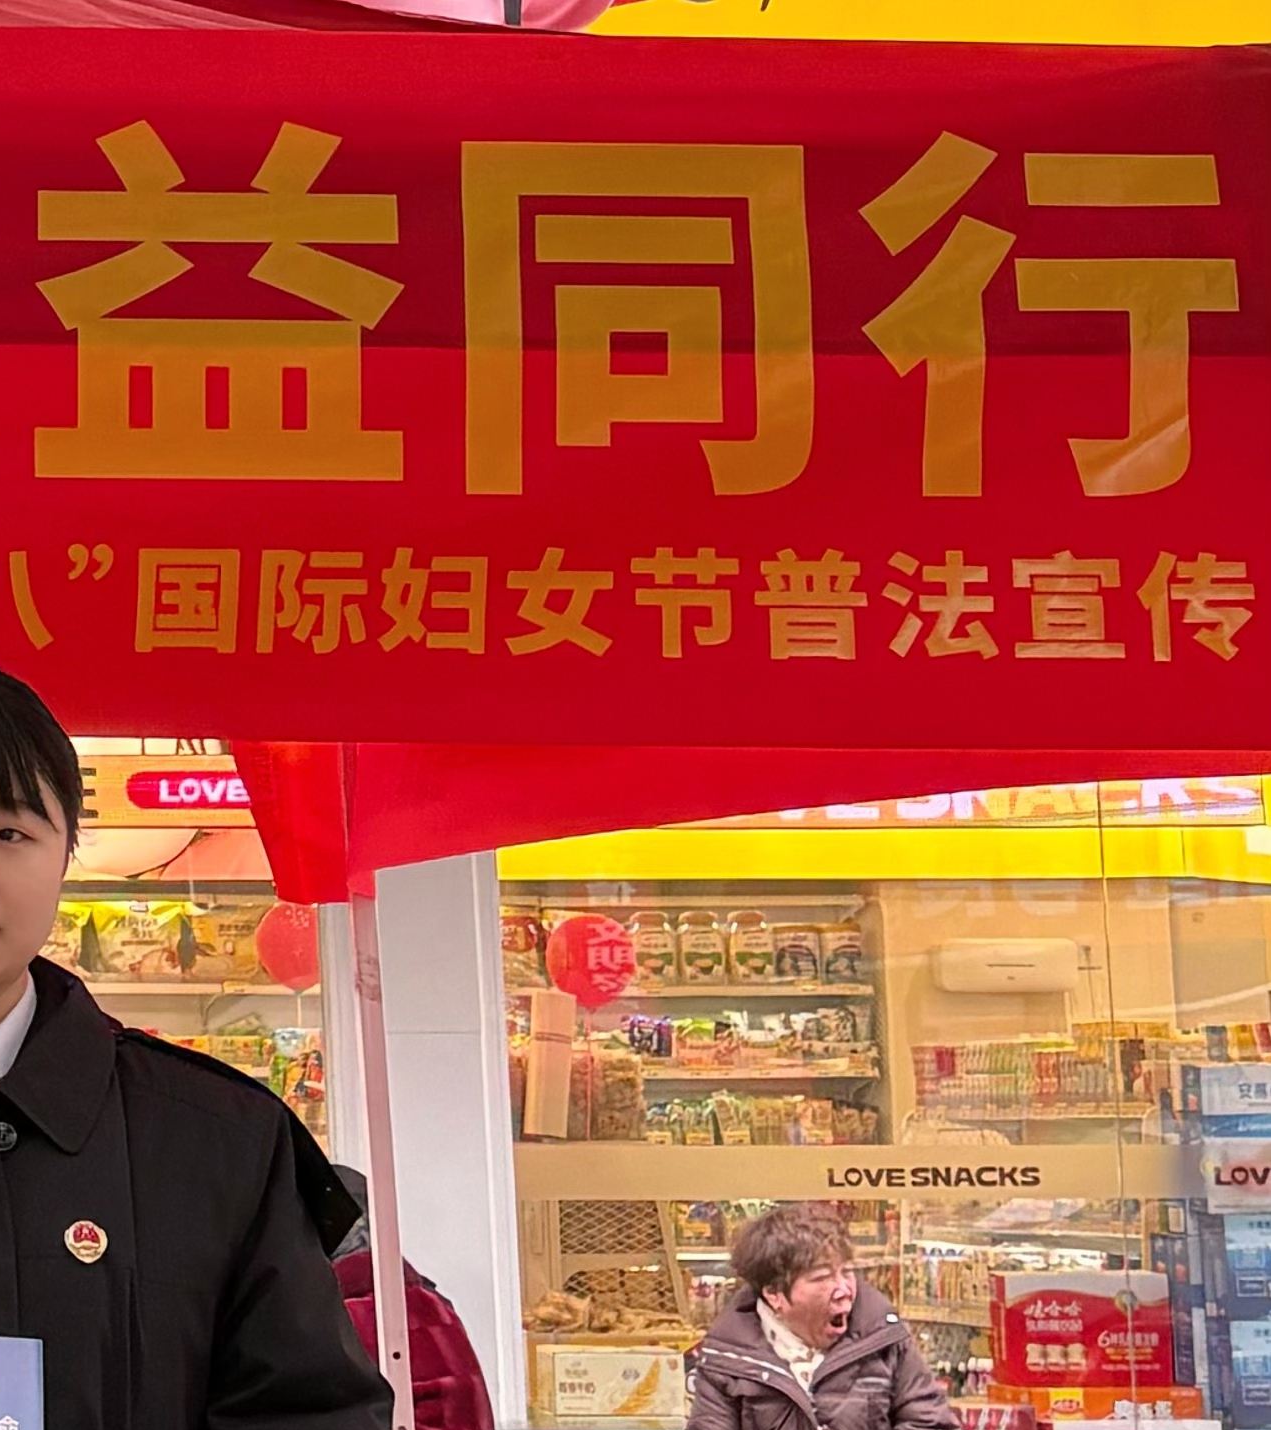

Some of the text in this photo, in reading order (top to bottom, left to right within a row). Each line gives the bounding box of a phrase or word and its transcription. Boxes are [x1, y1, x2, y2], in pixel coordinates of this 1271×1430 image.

[158, 777, 252, 804] LOVE
[827, 1166, 1041, 1188] LOVE SNACKS
